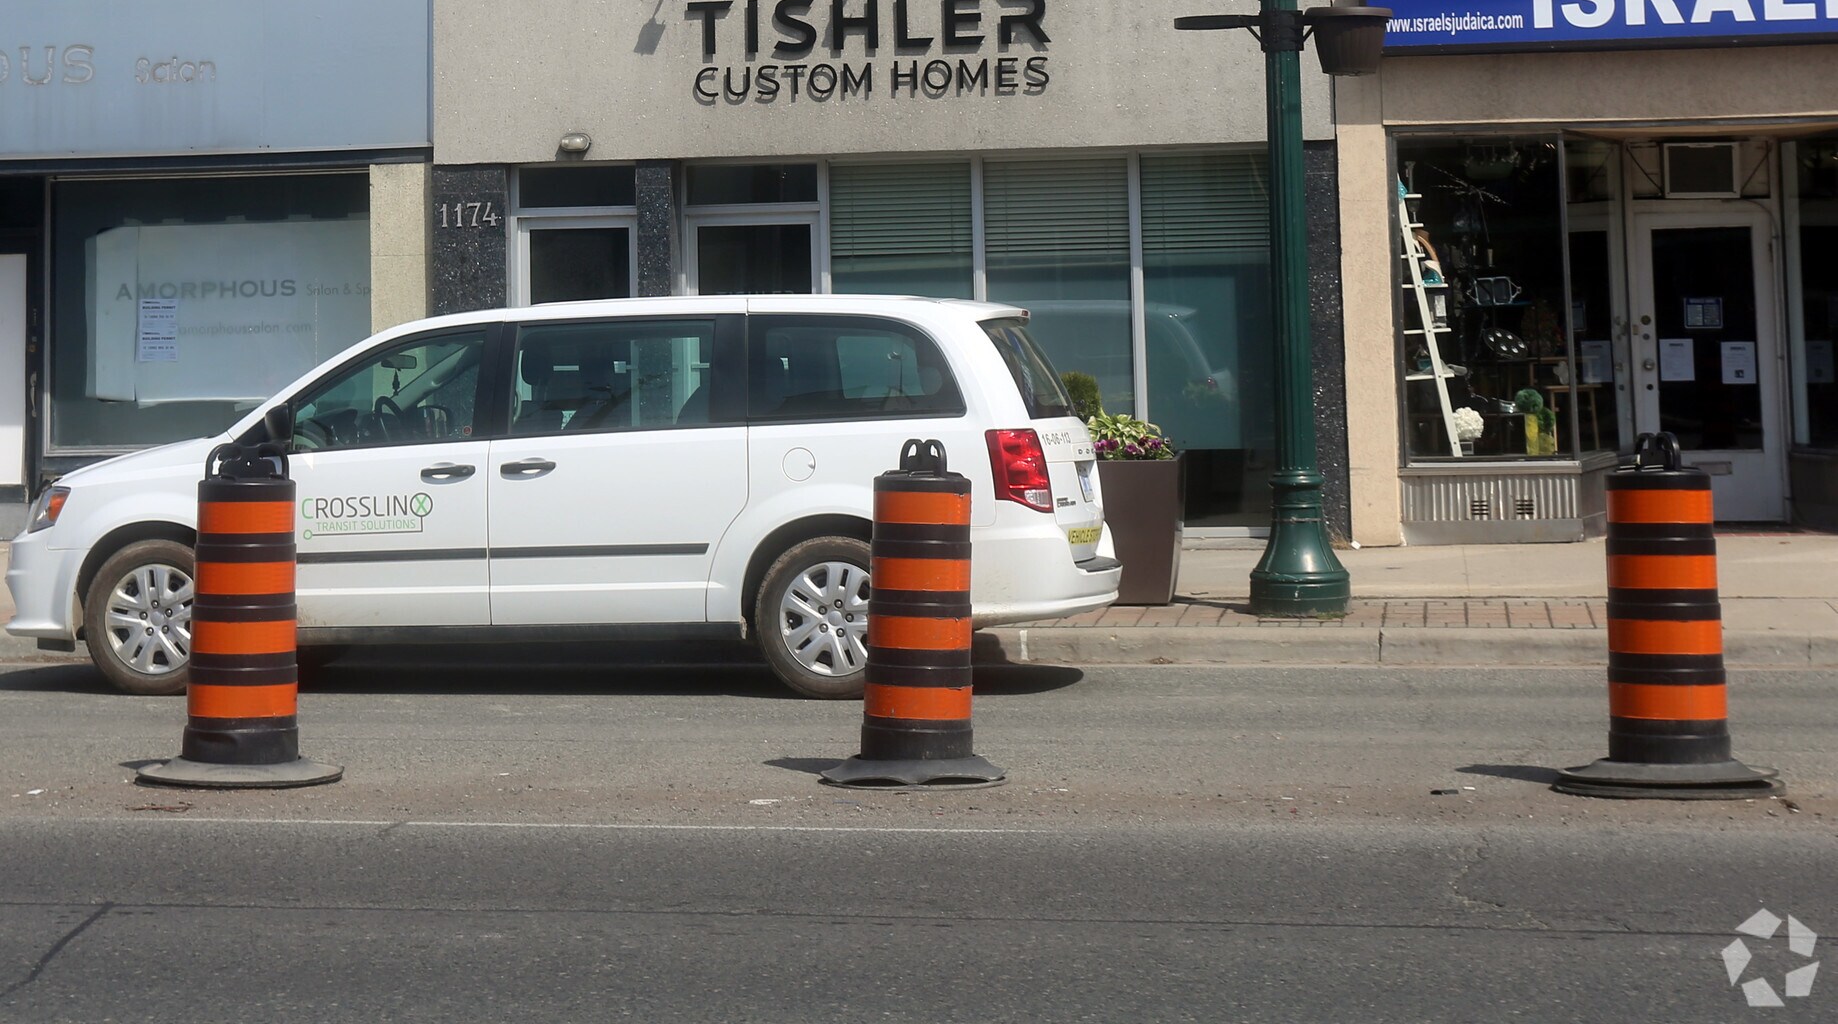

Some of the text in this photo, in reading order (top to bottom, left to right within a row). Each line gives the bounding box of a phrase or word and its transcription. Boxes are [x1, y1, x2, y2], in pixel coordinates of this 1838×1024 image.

[1385, 11, 1524, 36] www.israelsjudaica.com
[695, 57, 1050, 97] CUSTOM HOMES
[440, 202, 498, 228] 1174
[115, 279, 371, 301] AMORPHOUS Salon & Sp
[302, 492, 433, 519] CROSSLINX
[316, 519, 416, 532] TRANSIT SOLUTIONS
